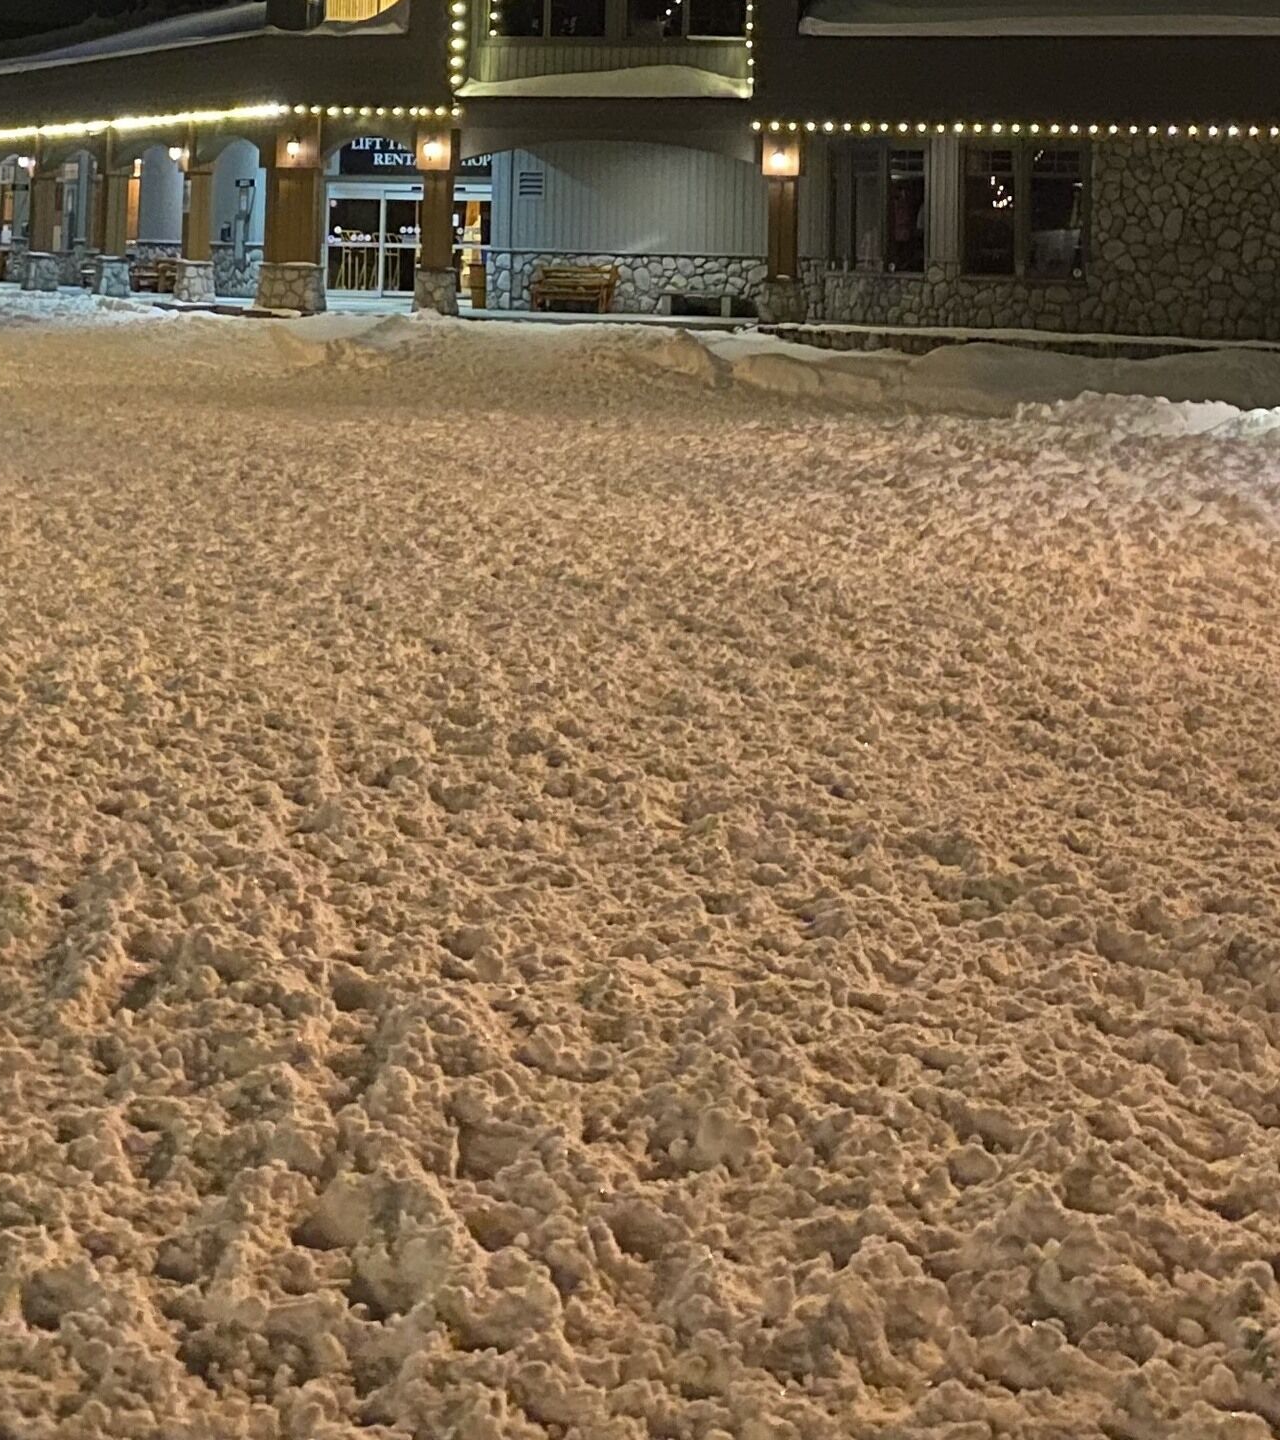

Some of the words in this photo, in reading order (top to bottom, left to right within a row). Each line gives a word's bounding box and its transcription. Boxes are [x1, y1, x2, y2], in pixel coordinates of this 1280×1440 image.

[351, 137, 384, 150] LIFT
[373, 152, 417, 166] RENT
[461, 154, 492, 166] HOP
